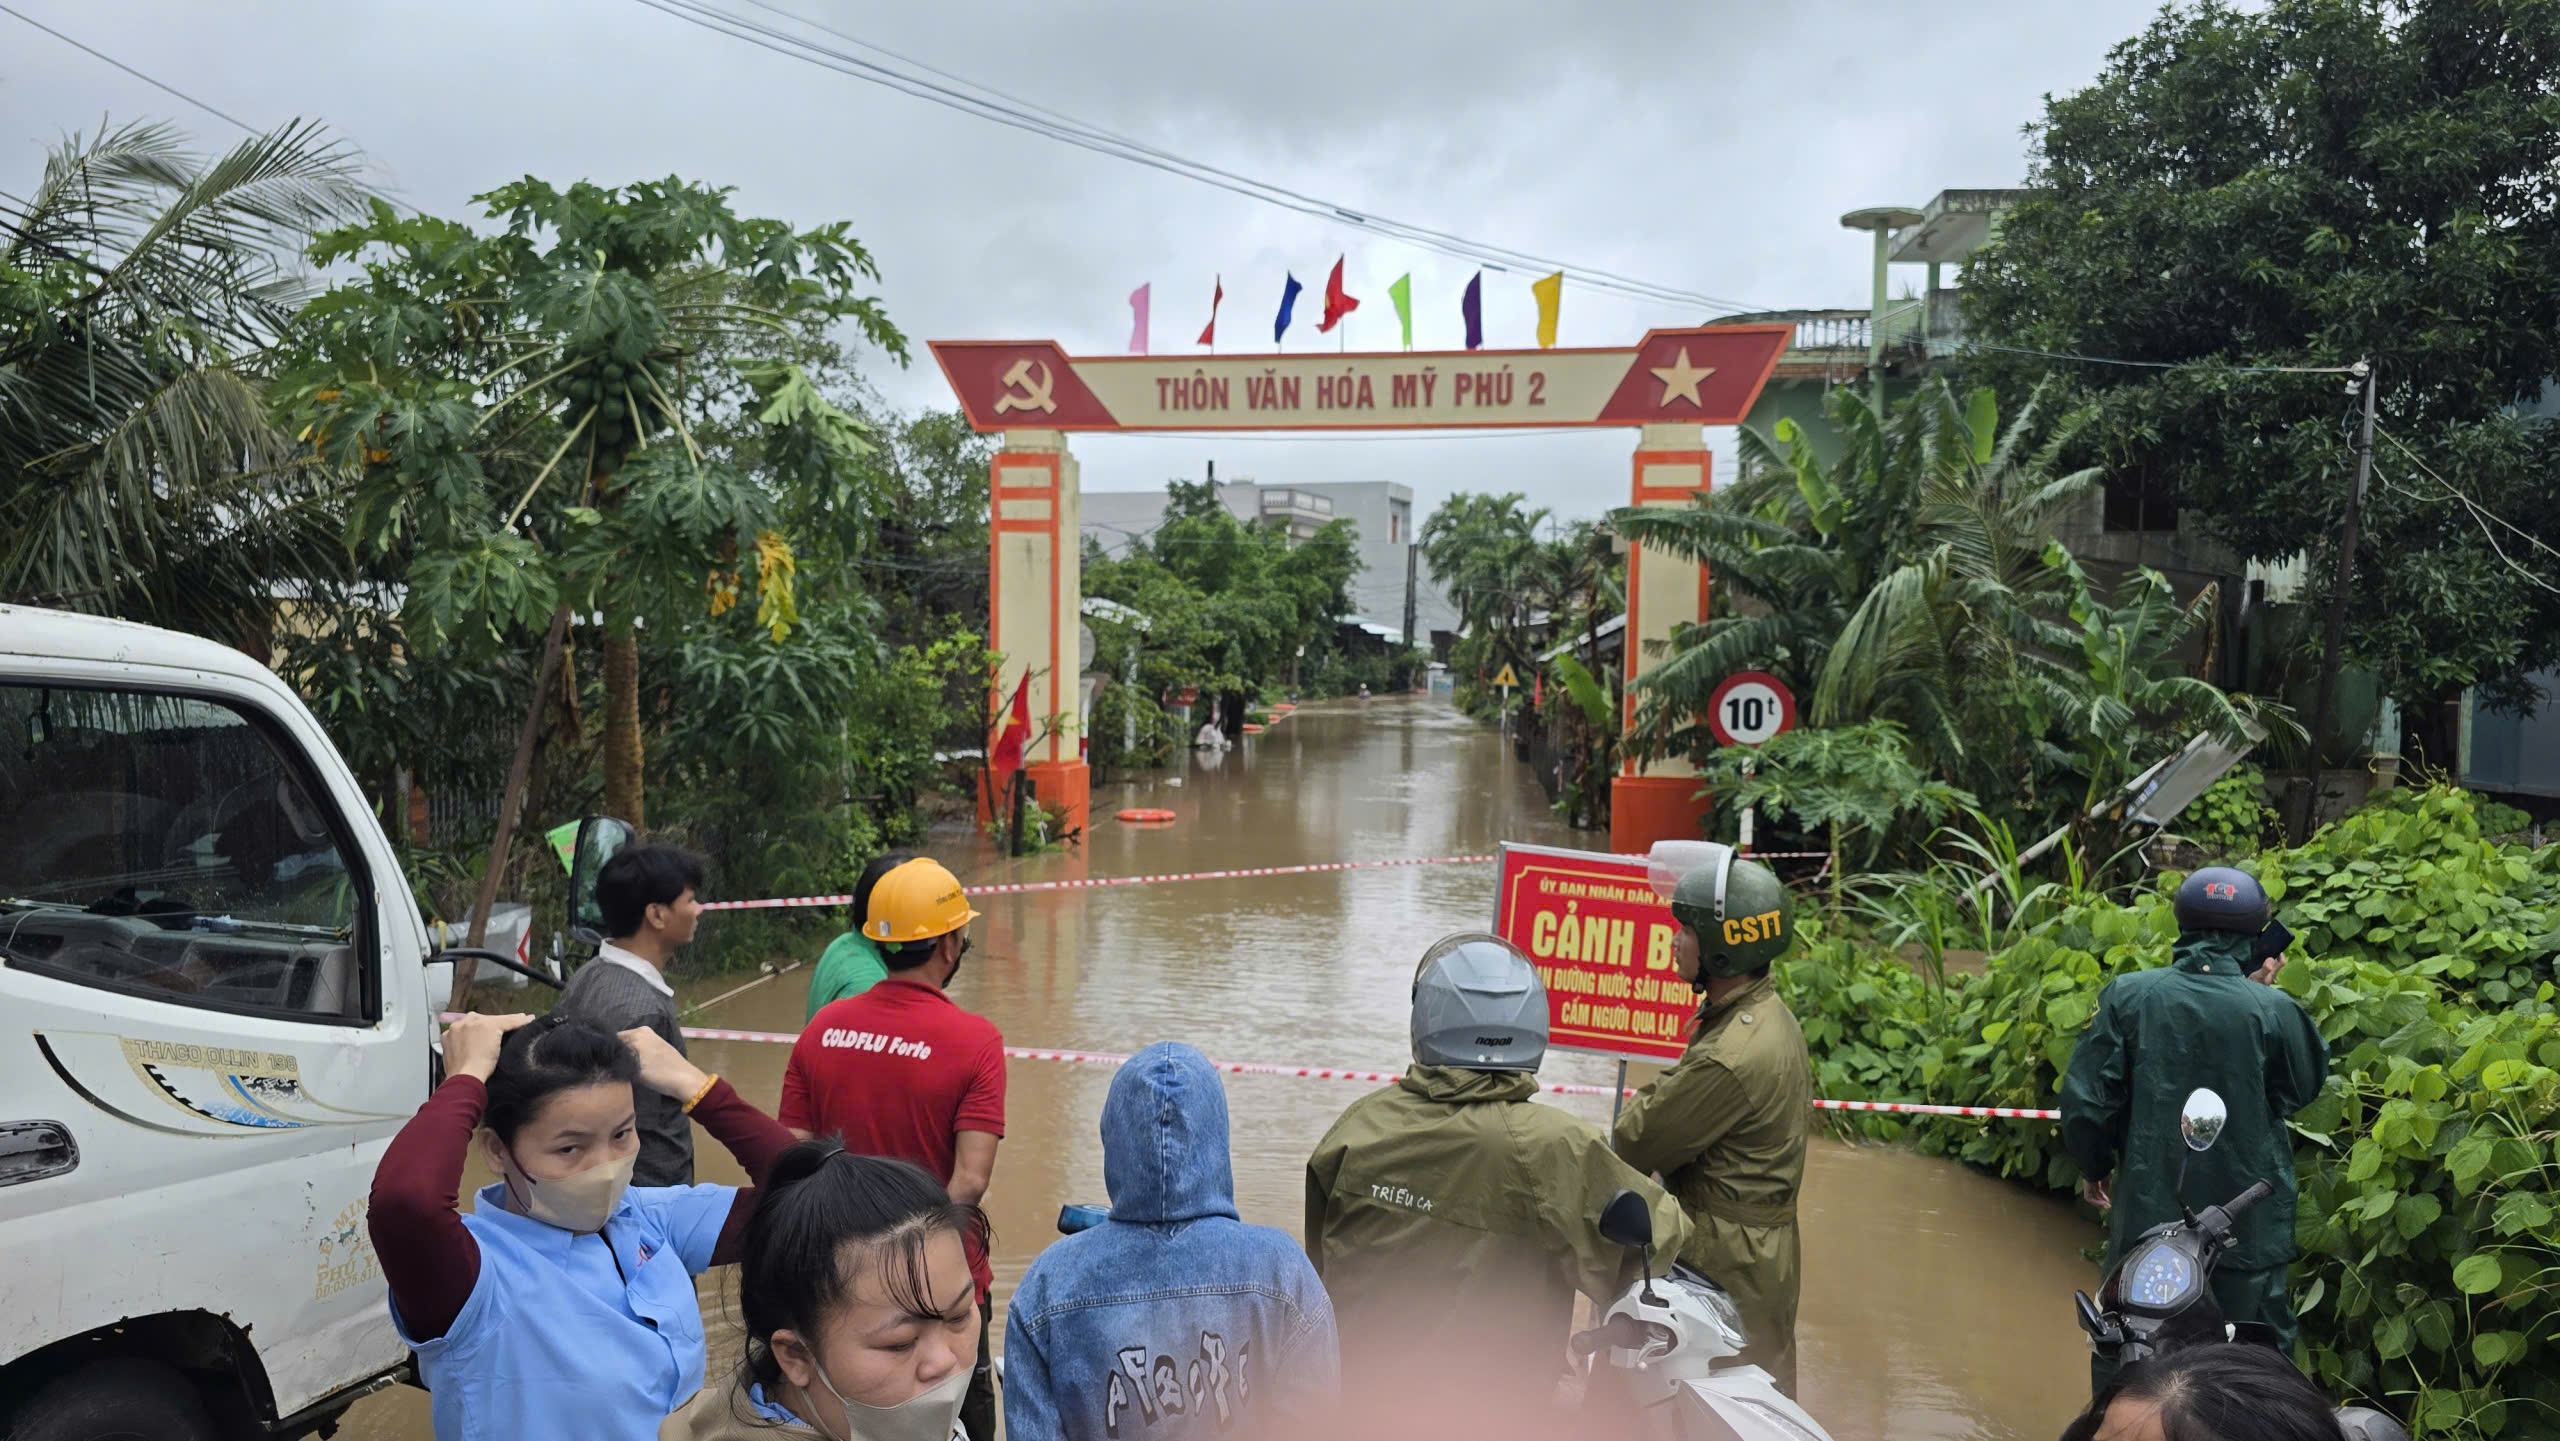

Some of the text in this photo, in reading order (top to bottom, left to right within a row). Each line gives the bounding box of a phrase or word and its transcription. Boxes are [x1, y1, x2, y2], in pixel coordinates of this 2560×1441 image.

[1156, 364, 1546, 410] THÔN VĂN HÓA MỸ PHÚ 2
[1559, 881, 1586, 897] BAN
[1588, 884, 1624, 901] NHÂN
[1627, 888, 1654, 905] DÂN
[1532, 900, 1635, 967] CẢNH
[1723, 909, 1781, 946] CSTT
[1598, 971, 1632, 999] NƯỚC
[1633, 975, 1660, 1003] SÂU
[1661, 979, 1694, 1007] NGUY
[1561, 996, 1680, 1041] CẤM NGƯỜI QUA LẠI
[136, 1040, 298, 1072] THACO OLLIN 198
[821, 1027, 932, 1060] COLDFLU Forte
